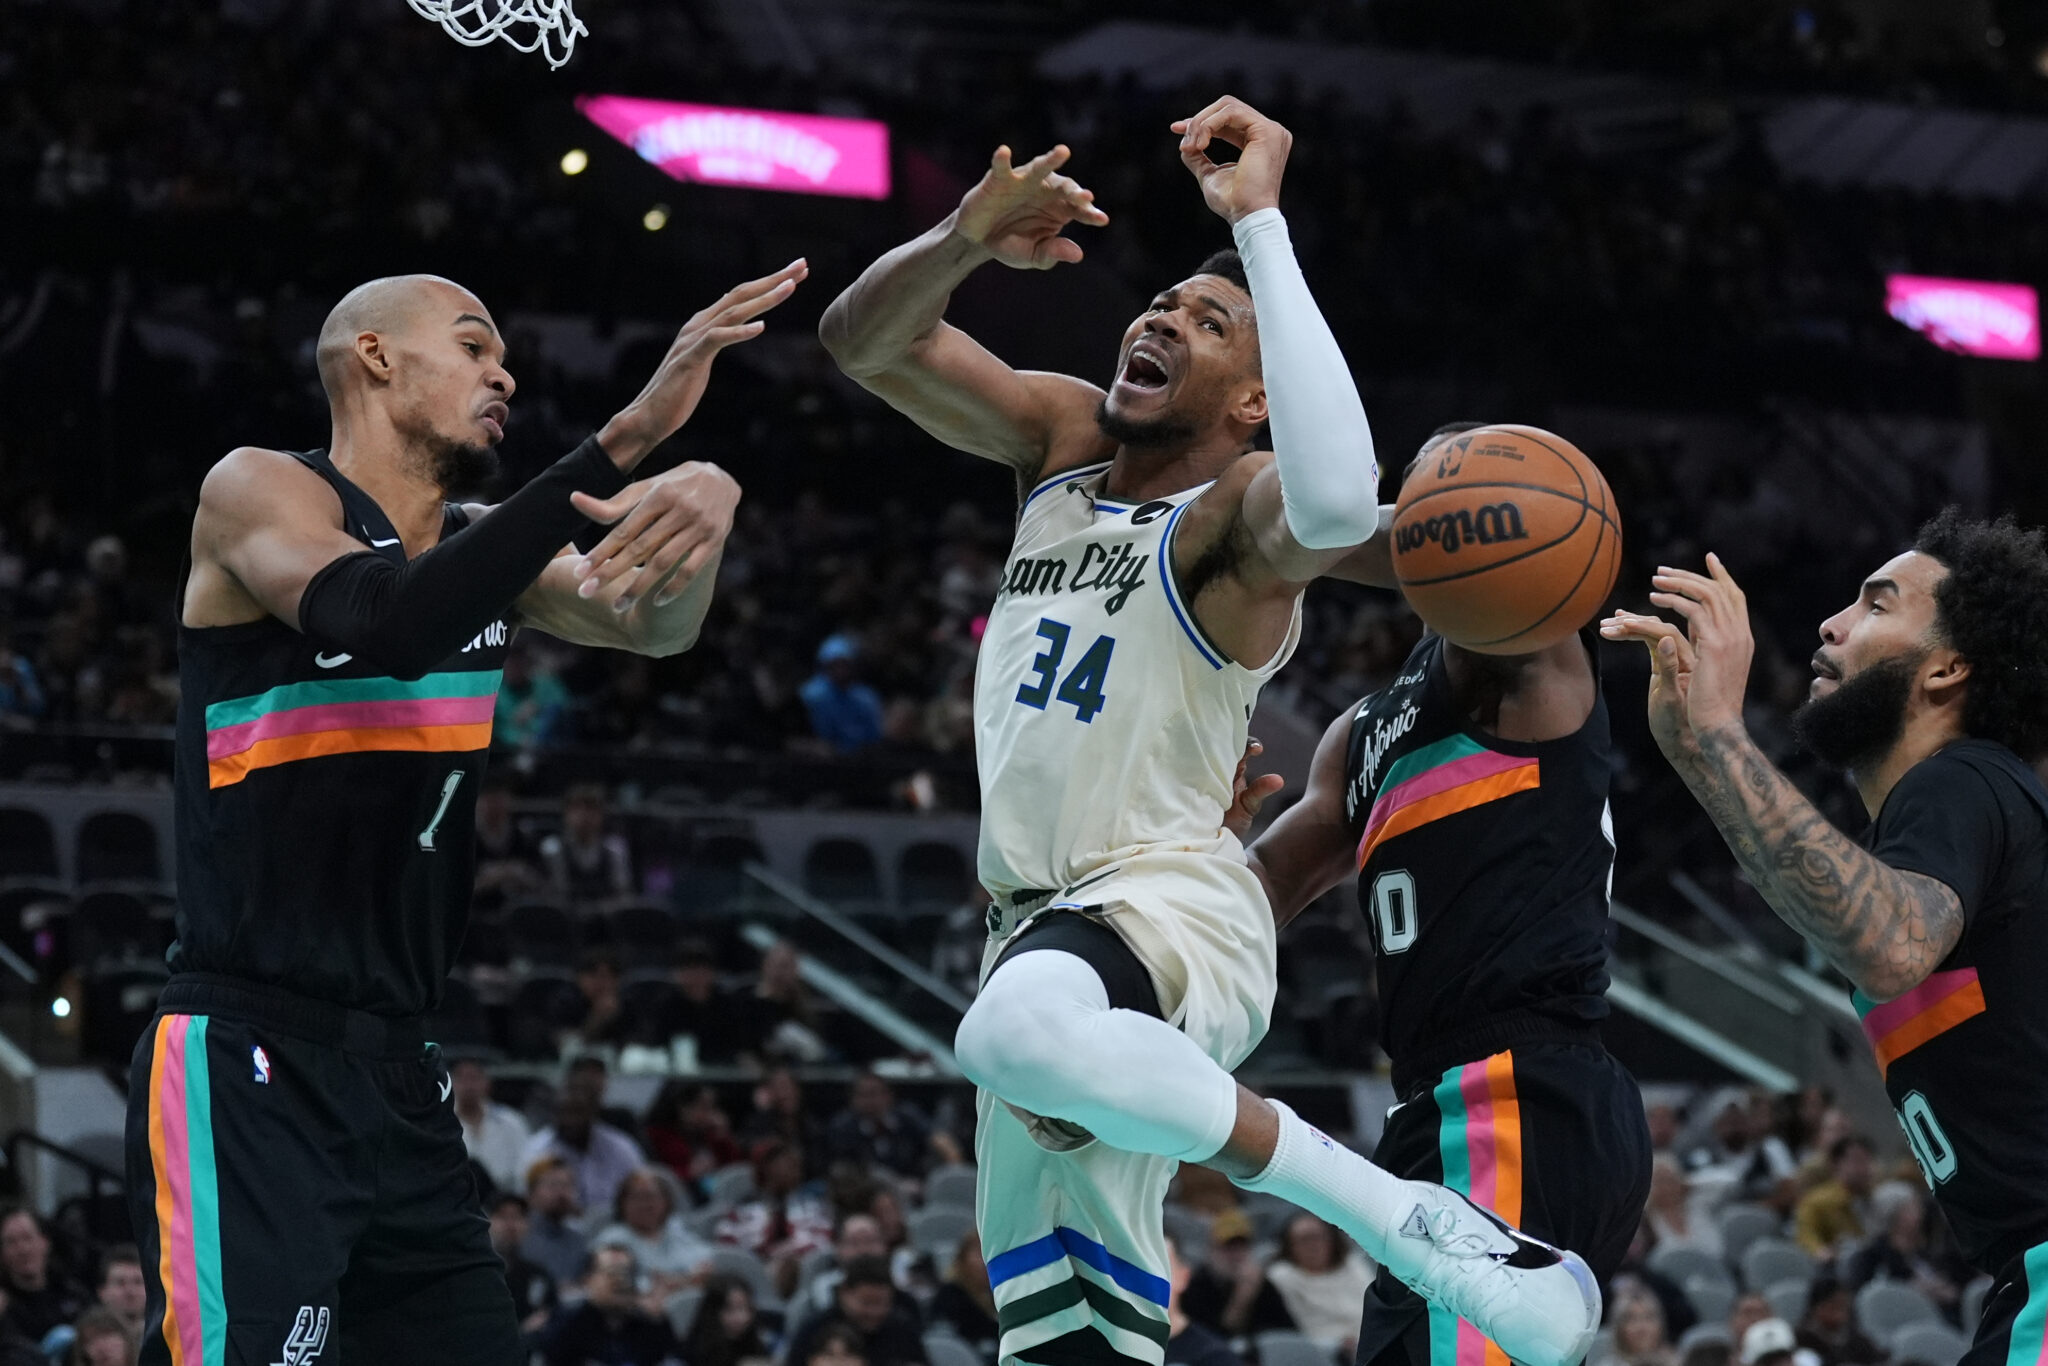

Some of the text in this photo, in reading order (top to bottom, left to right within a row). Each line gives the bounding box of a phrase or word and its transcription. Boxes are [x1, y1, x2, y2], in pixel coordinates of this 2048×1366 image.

[1396, 500, 1529, 555] Wilson
[1069, 542, 1149, 616] City
[1015, 617, 1116, 724] 34
[1358, 699, 1420, 798] Antonio
[418, 769, 465, 852] 1
[1369, 868, 1418, 957] 0
